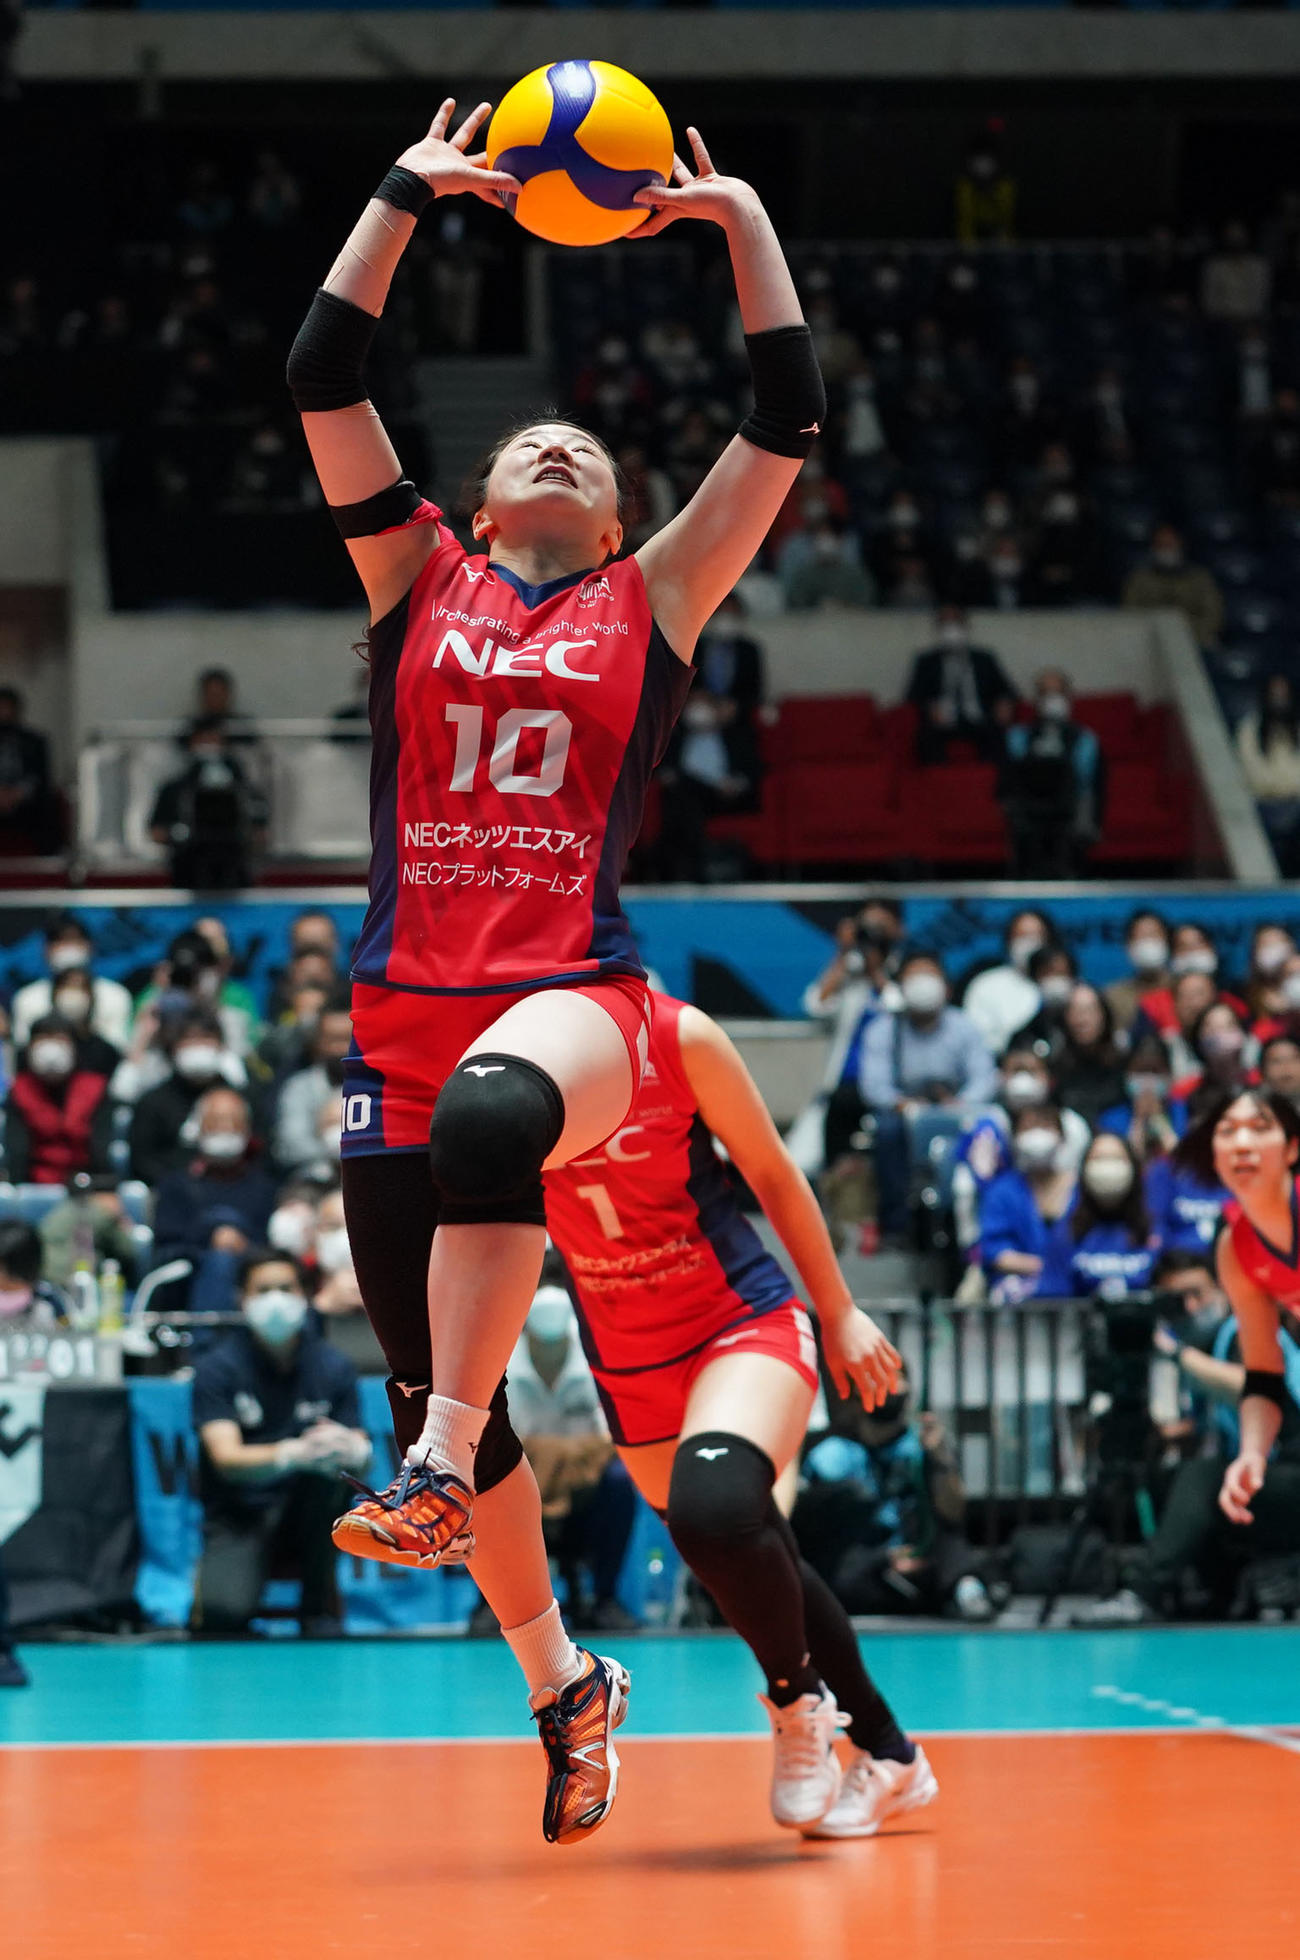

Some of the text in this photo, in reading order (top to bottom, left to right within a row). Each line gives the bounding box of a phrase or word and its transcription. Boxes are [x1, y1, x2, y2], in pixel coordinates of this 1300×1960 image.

[432, 629, 600, 682] NEC
[521, 636, 532, 645] a
[445, 703, 573, 797] 10
[404, 822, 592, 859] NECネッツエスアイ
[402, 862, 587, 896] NECプラットフォームズ
[577, 1184, 624, 1240] 1
